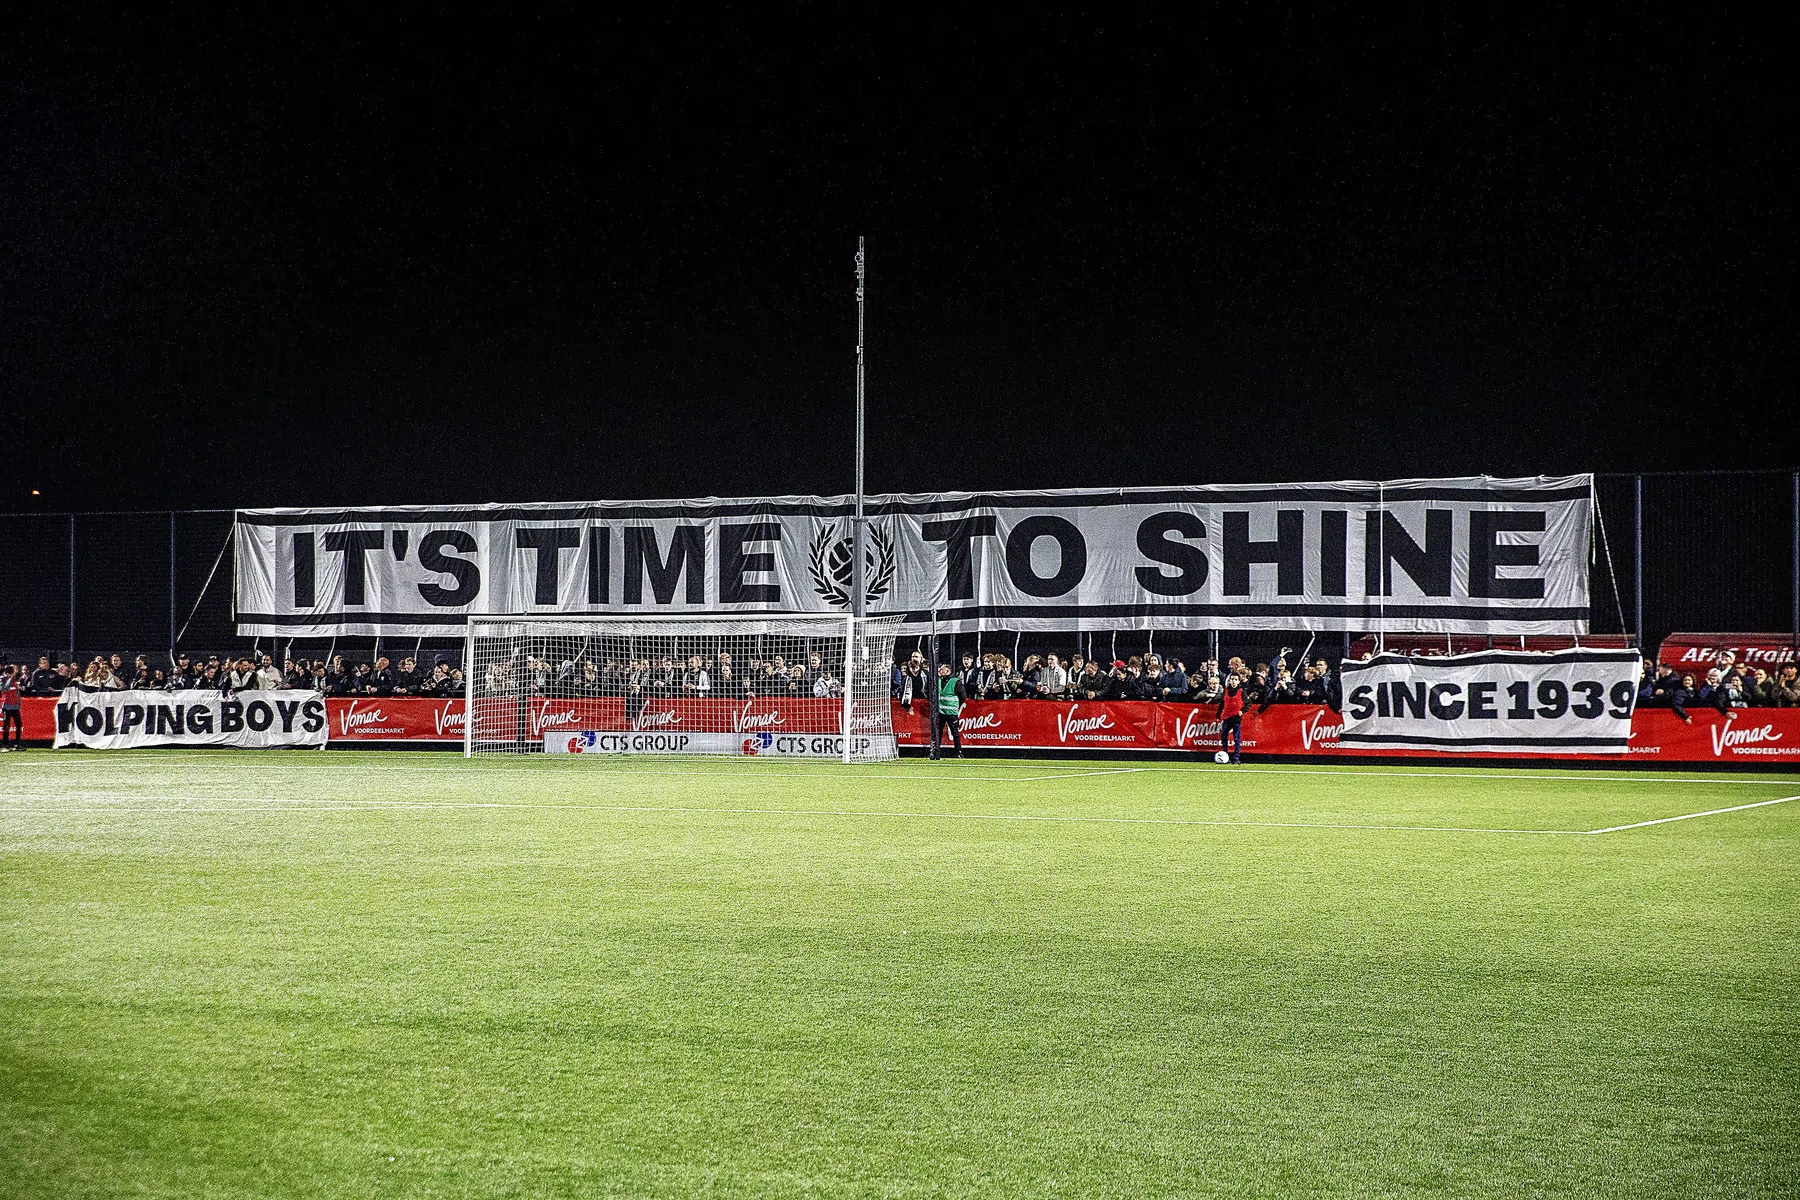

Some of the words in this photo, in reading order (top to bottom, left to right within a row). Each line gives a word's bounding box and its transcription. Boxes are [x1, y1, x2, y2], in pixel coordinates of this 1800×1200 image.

[292, 529, 481, 608] IT'S
[516, 522, 782, 606] TIME
[921, 511, 1087, 601] TO
[1134, 508, 1548, 599] SHINE
[1348, 680, 1498, 720] SINCE
[1506, 680, 1636, 720] 1939
[220, 700, 325, 734] BOYS
[600, 735, 629, 751] CTS
[633, 735, 689, 751] GROUP
[776, 737, 807, 754] CTS
[1075, 734, 1136, 742] VOORDEELMARKT
